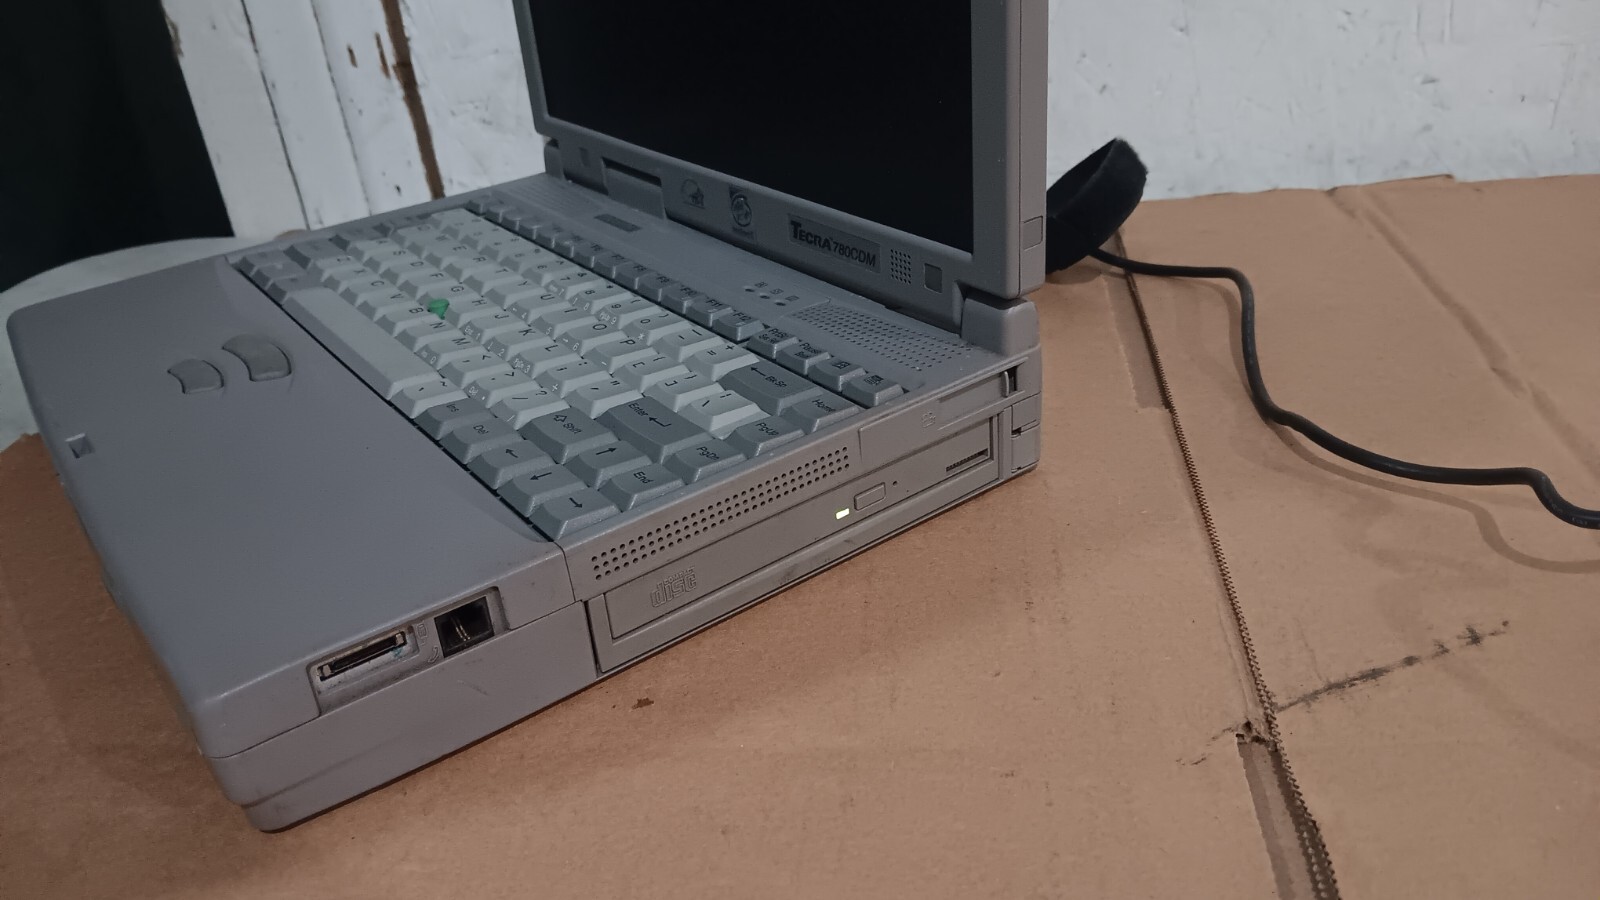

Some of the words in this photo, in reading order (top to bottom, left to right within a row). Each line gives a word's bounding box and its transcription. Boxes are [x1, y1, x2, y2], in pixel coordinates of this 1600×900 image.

[832, 240, 877, 268] 780CDM
[450, 285, 466, 293] G
[540, 293, 556, 301] U
[471, 299, 488, 307] H
[429, 321, 446, 329] N
[518, 327, 537, 337] K
[451, 337, 471, 346] M
[544, 344, 559, 352] L
[446, 402, 460, 413] Ins
[627, 402, 649, 418] Enter
[811, 399, 837, 414] Home
[473, 424, 490, 435] Del
[563, 421, 583, 435] Shift
[754, 421, 781, 437] PgUp
[695, 445, 722, 462] PgDn
[632, 470, 654, 485] End
[650, 572, 697, 608] disc
